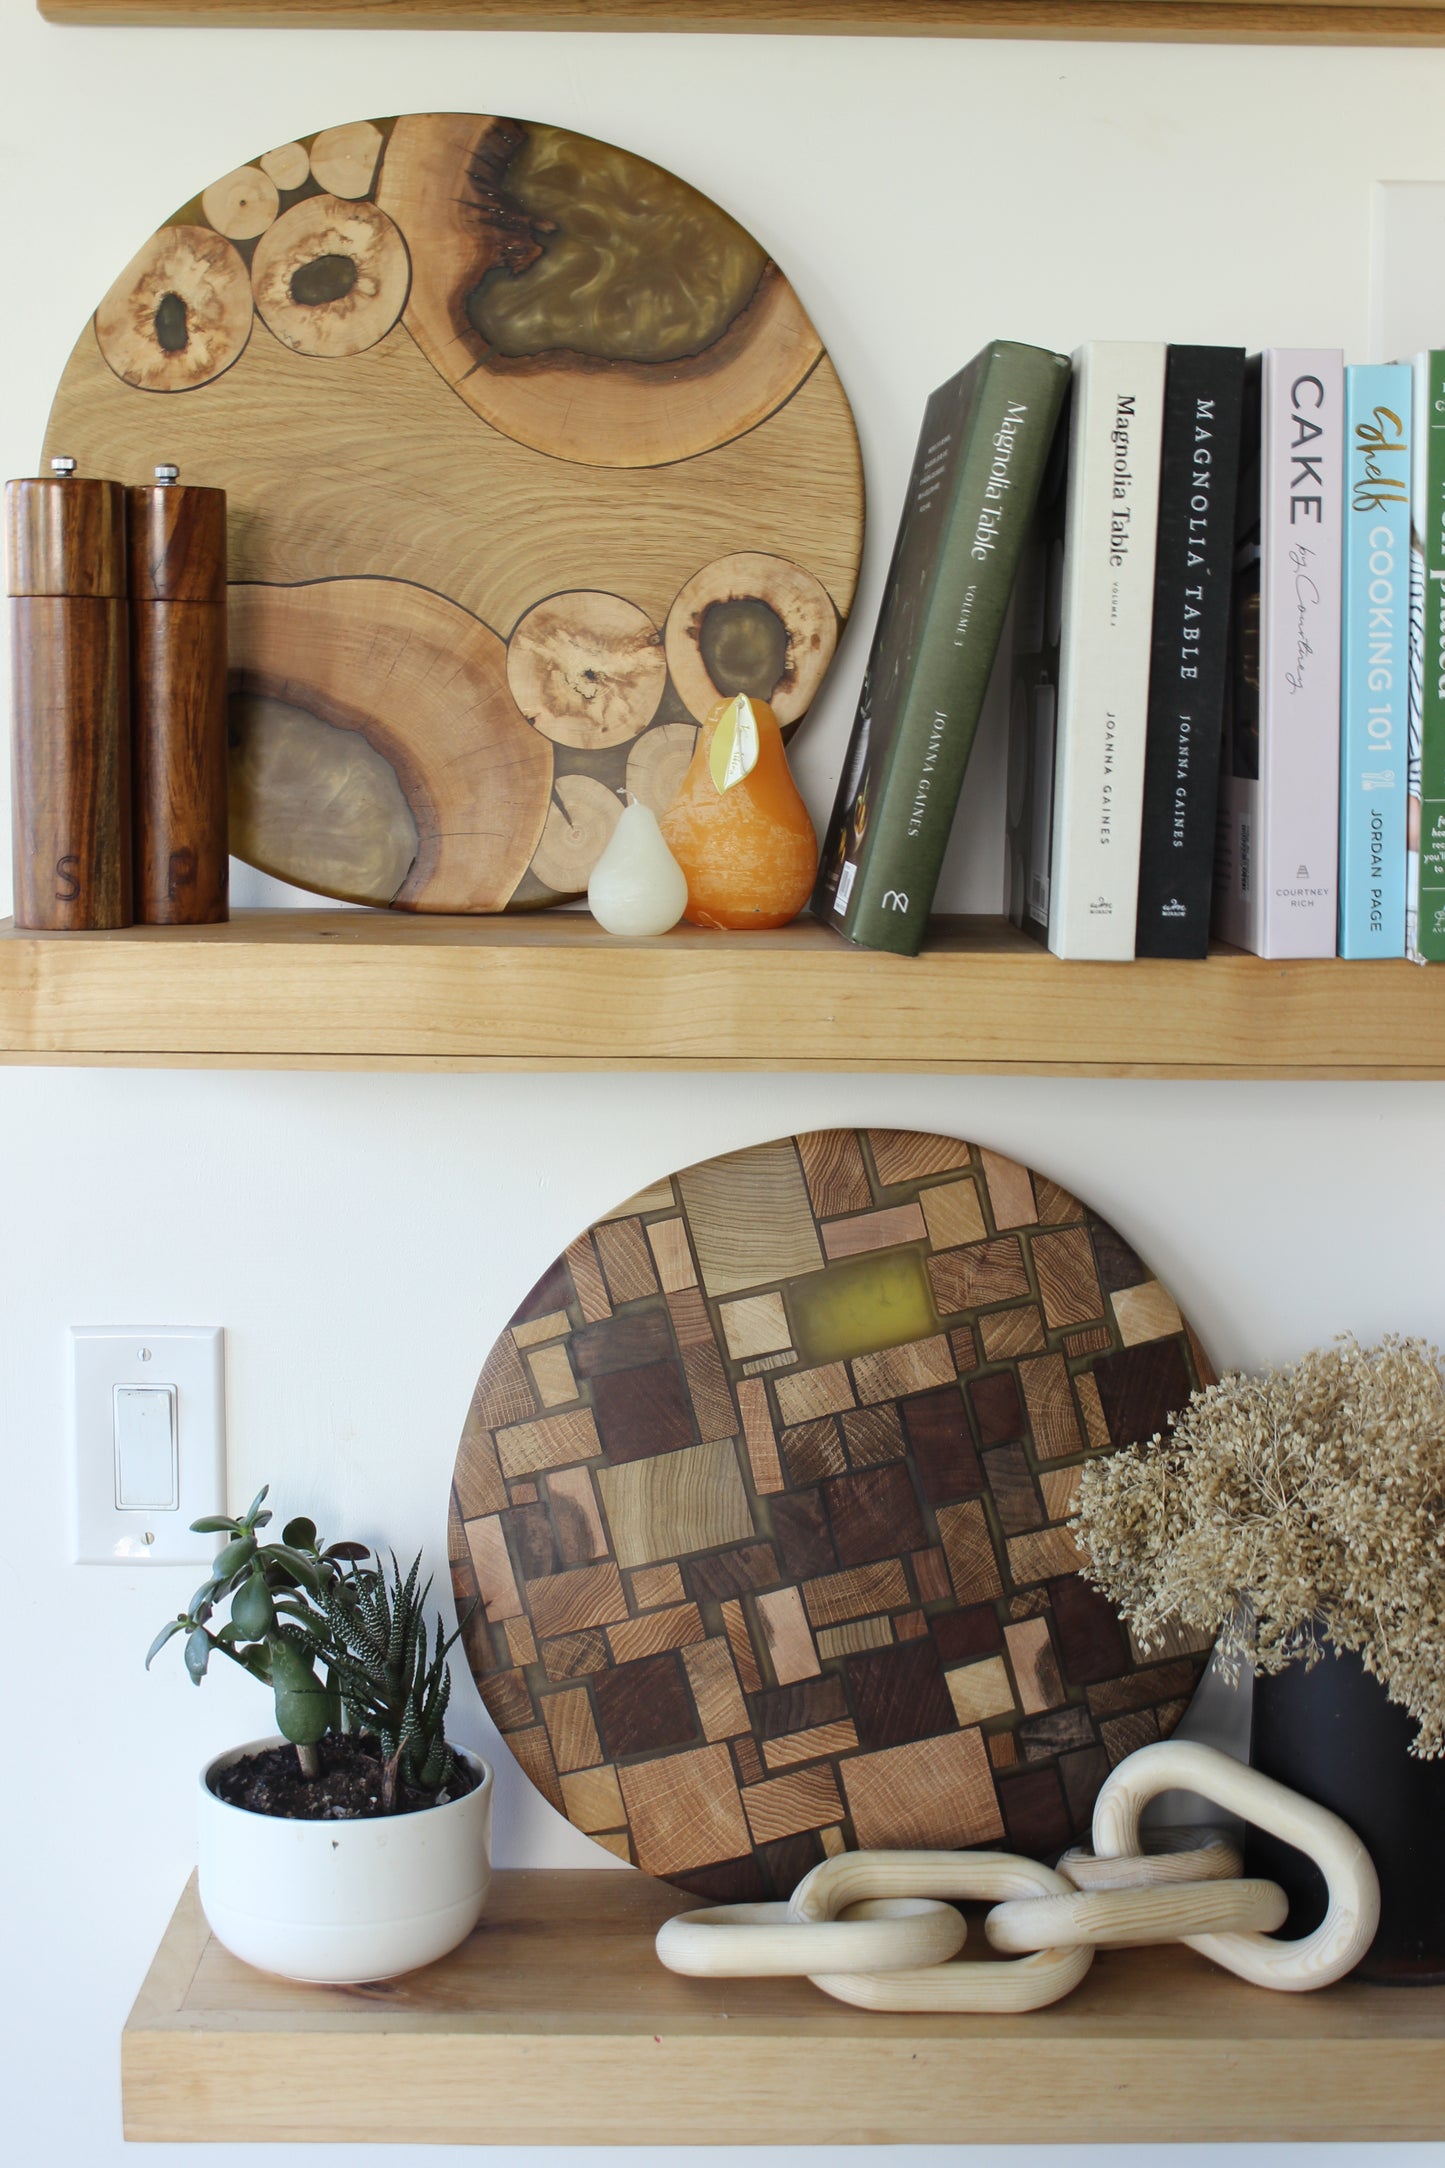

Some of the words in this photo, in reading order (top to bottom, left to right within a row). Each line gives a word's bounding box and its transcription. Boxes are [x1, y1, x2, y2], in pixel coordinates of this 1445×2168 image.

[984, 400, 1028, 500] Magnolia
[1110, 394, 1136, 500] Magnolia
[1290, 375, 1324, 525] CAKE
[1352, 406, 1409, 513] Shelf
[1187, 398, 1215, 568] MAGNOLIA
[971, 506, 1004, 561] Table
[1109, 506, 1131, 568] Table
[1288, 542, 1316, 573] by
[956, 584, 977, 635] VOLUME
[1180, 585, 1203, 680] TABLE
[1367, 525, 1394, 692] COOKING
[922, 710, 948, 773] JOANNA
[1104, 712, 1116, 775] JOANNA
[1177, 714, 1191, 779] JOANNA
[1367, 703, 1393, 752] 101
[907, 779, 931, 838] GAINES
[1100, 785, 1112, 845] GAINES
[1173, 787, 1187, 848] GAINES
[1370, 808, 1383, 879] JORDAN
[55, 854, 81, 901] S
[1275, 888, 1329, 897] COURTNEY
[1290, 899, 1315, 908] RICH
[1370, 888, 1383, 933] PAGE
